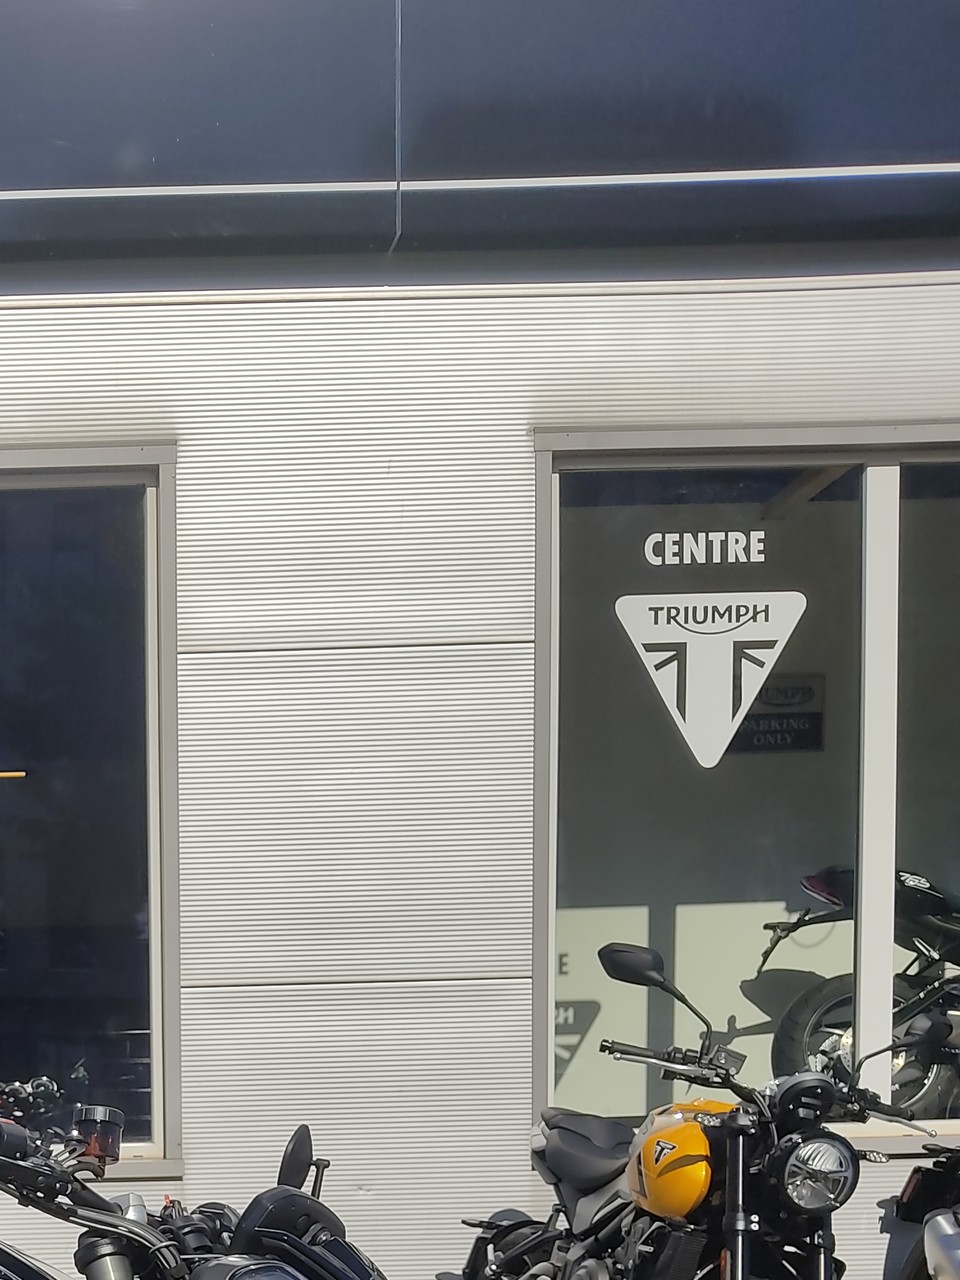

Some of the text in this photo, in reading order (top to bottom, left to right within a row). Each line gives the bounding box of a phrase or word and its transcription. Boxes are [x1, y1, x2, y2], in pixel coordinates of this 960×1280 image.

[644, 531, 765, 565] CENTRE
[648, 604, 770, 634] TRIUMPH
[754, 733, 794, 745] ONLY
[899, 872, 930, 888] 765
